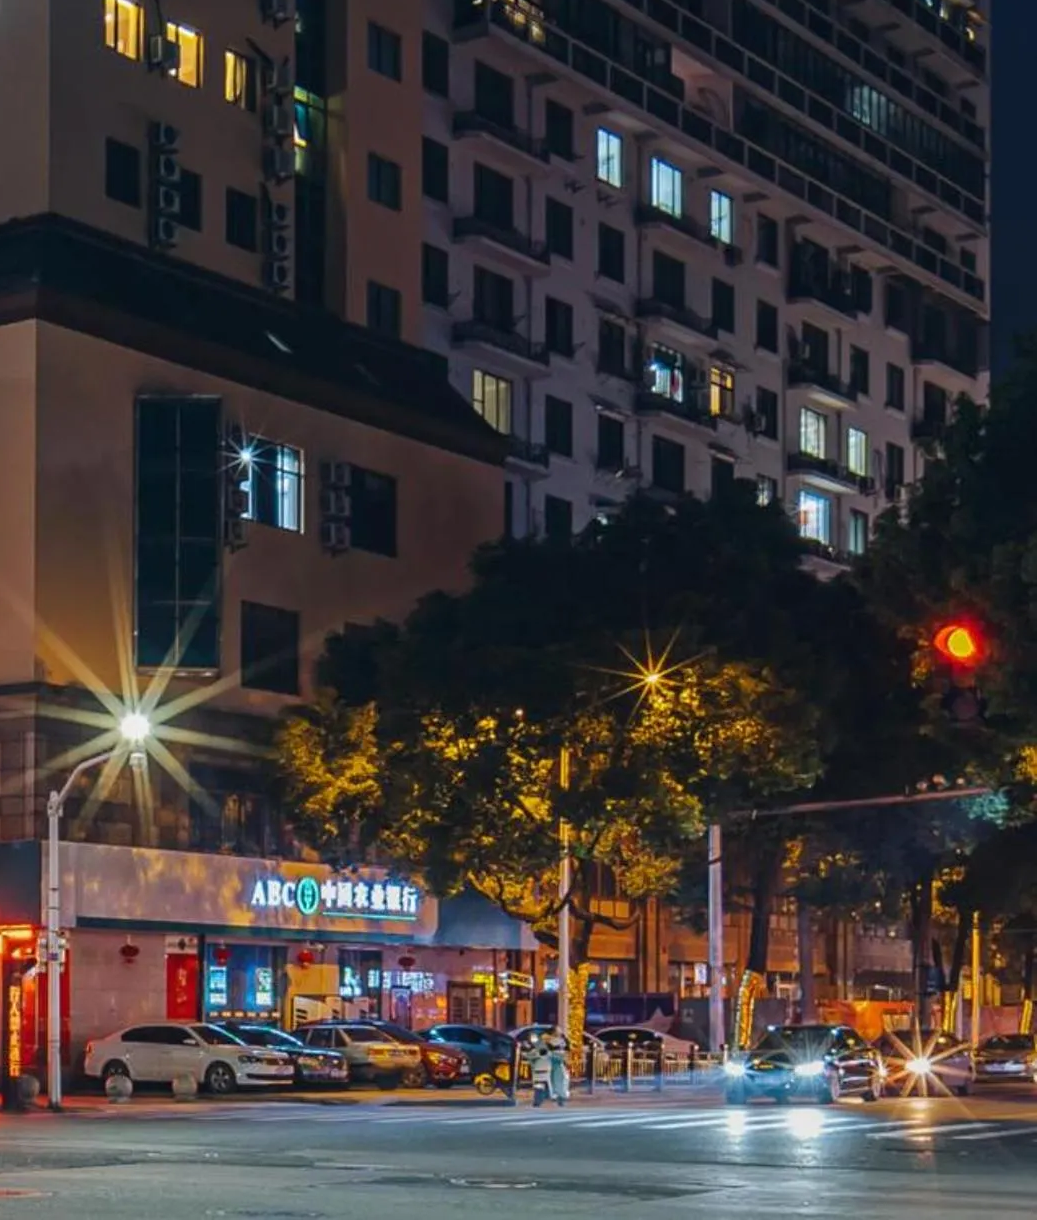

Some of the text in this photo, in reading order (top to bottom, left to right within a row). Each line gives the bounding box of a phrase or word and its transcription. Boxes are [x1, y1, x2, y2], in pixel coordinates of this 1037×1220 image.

[251, 880, 418, 913] ABC 中国农业银行
